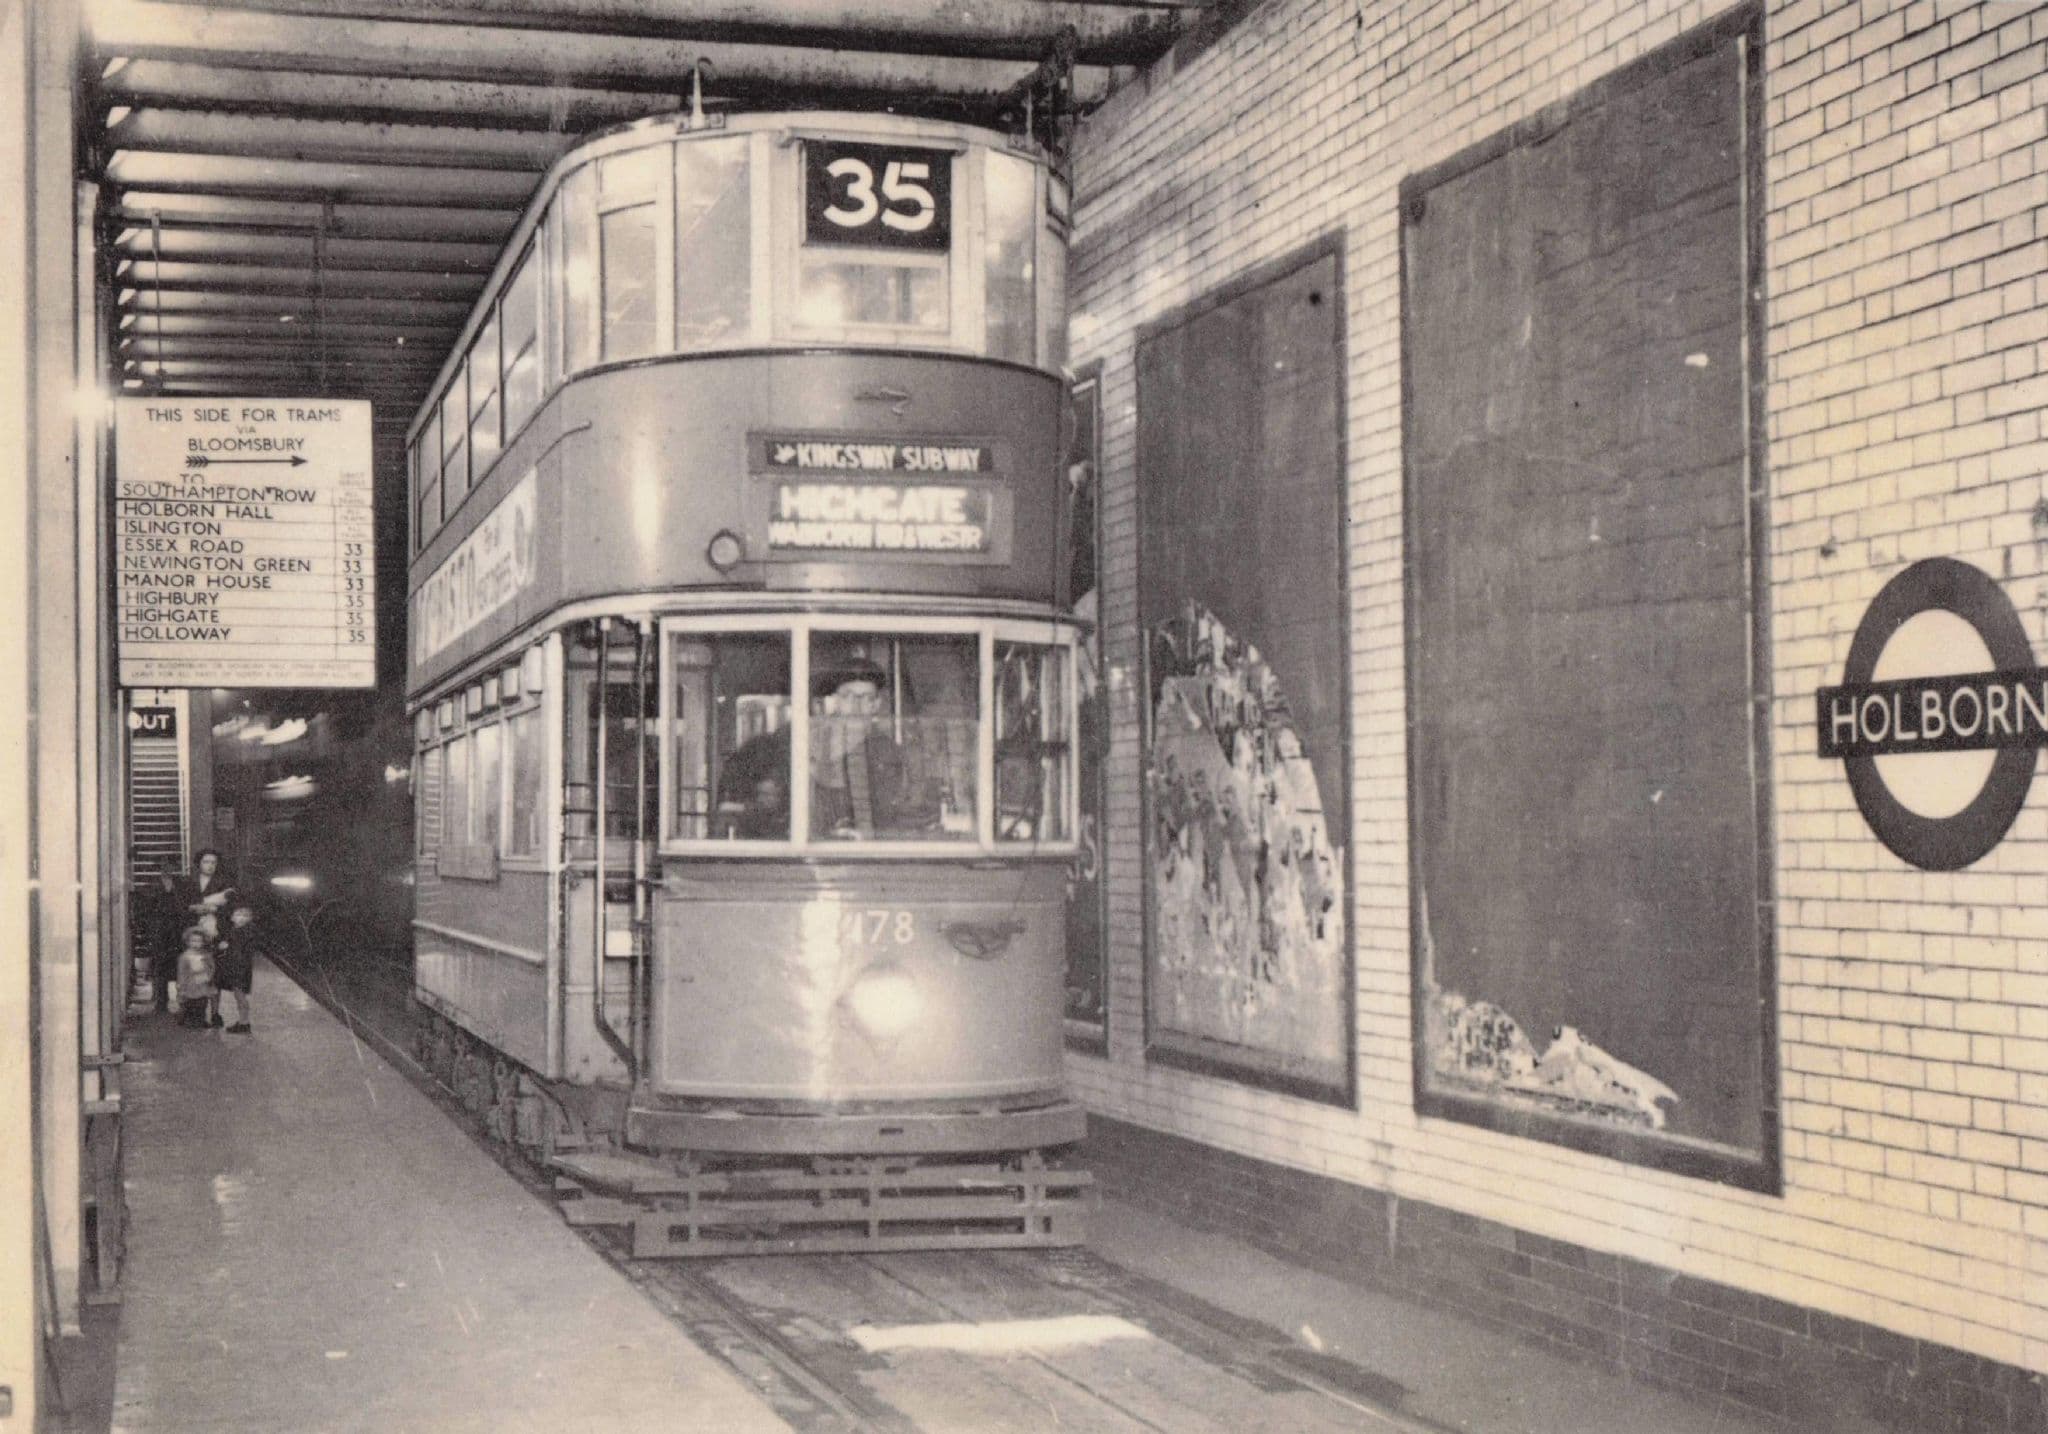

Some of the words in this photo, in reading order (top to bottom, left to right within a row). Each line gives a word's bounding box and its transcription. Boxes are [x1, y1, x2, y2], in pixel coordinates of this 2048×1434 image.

[823, 157, 935, 232] 35
[147, 408, 183, 422] THIS
[194, 408, 231, 422] SIDE
[242, 408, 277, 422] FOR
[287, 408, 341, 422] TRAMS
[236, 425, 257, 435] VIA
[188, 438, 304, 452] BLOOMSBURY
[797, 443, 896, 469] KINGSWAY
[902, 446, 980, 471] SUBWAY
[123, 484, 265, 501] SOUTHAMPTON
[275, 489, 316, 503] ROW
[124, 503, 215, 518] HOLBORN
[226, 505, 274, 520] HALL
[124, 520, 221, 535] ISLINGTON
[125, 538, 177, 552] ESSEX
[190, 540, 244, 554] ROAD
[344, 543, 363, 556] 33
[124, 555, 243, 571] NEWINGTON
[254, 558, 311, 572] GREEN
[343, 560, 361, 573] 33
[123, 574, 195, 588] MANOR
[206, 575, 272, 589] HOUSE
[345, 577, 364, 591] 33
[125, 591, 219, 605] HIGHBURY
[125, 609, 219, 623] HIGHGATE
[125, 626, 231, 640] HOLLOWAY
[348, 629, 366, 642] 35
[1832, 682, 2048, 744] HOLBORN
